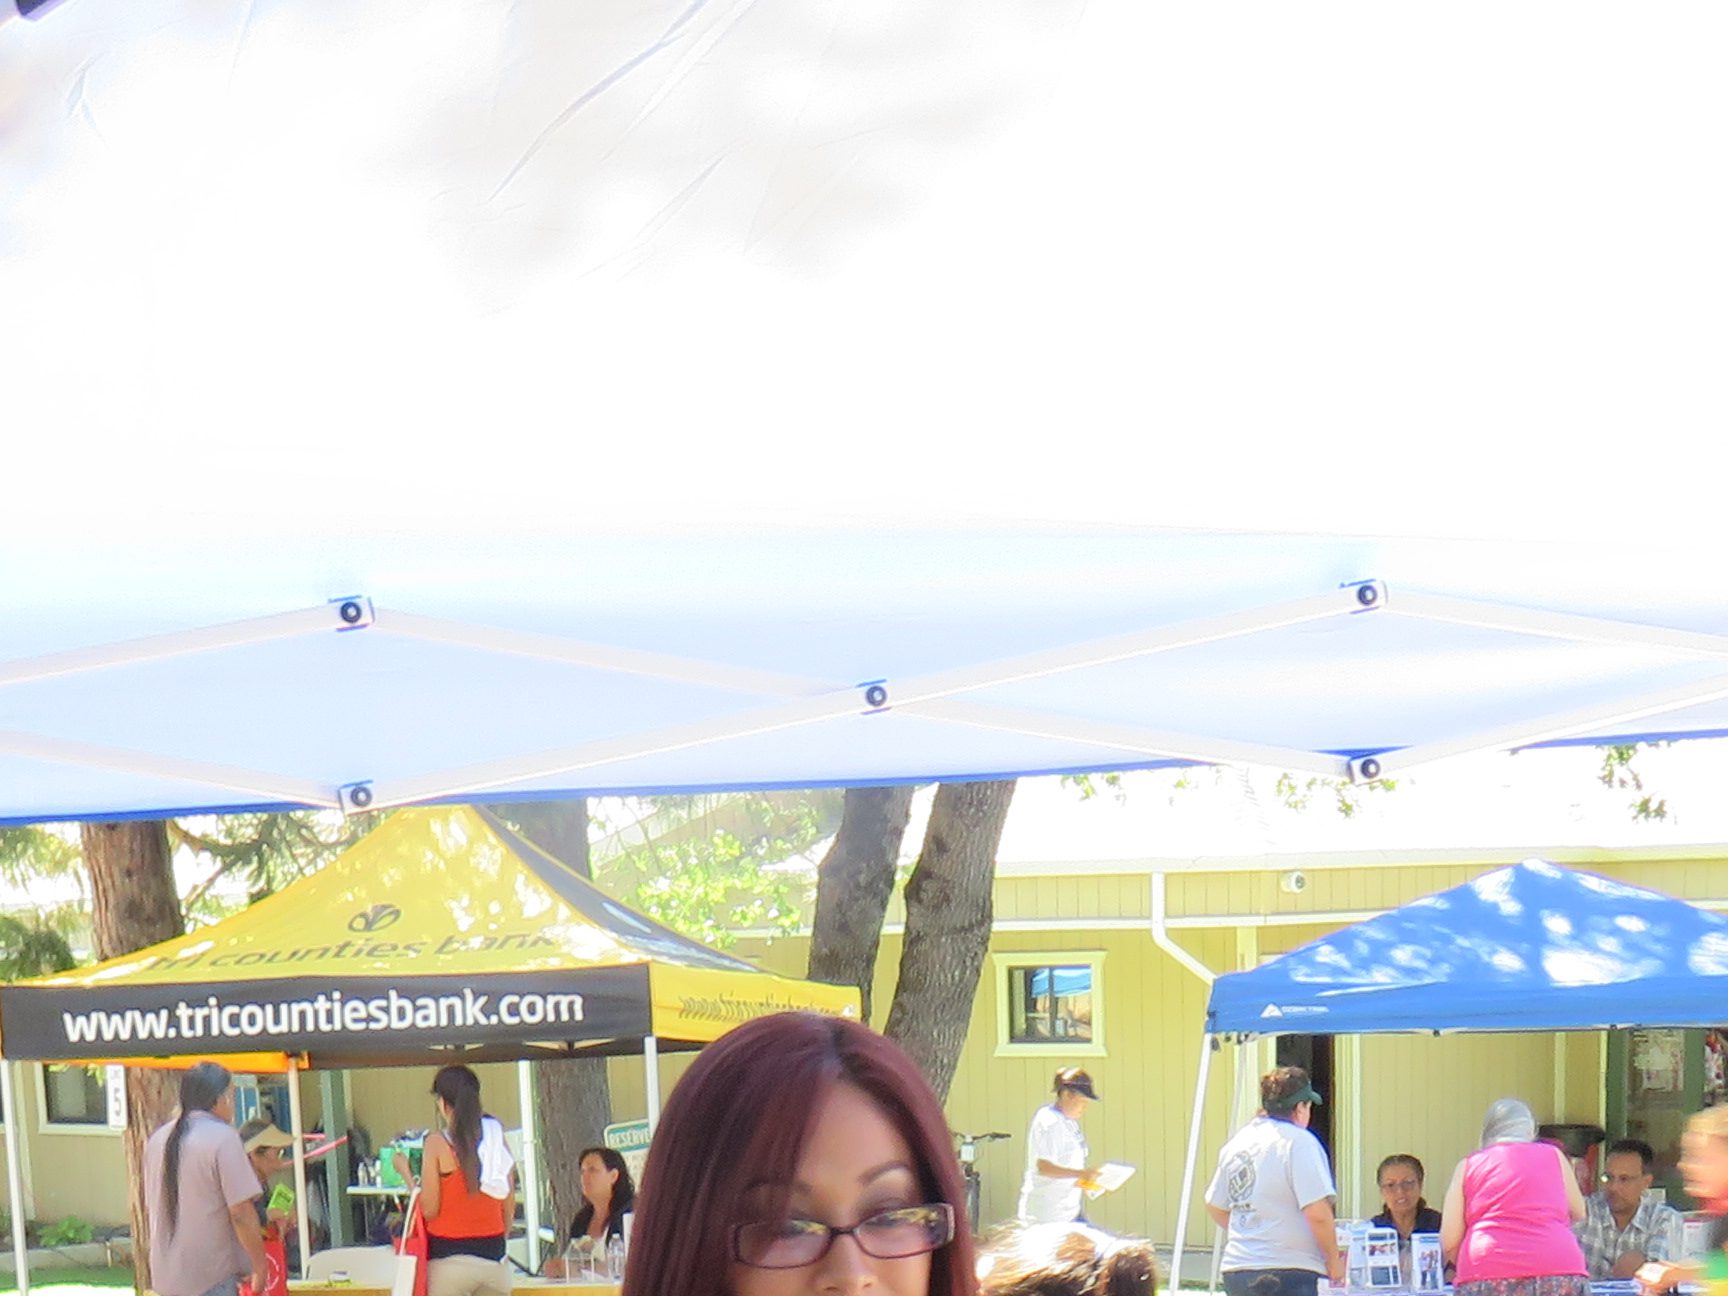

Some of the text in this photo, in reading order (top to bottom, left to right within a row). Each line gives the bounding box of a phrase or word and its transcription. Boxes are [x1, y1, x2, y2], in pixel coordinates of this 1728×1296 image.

[208, 938, 429, 968] counties
[432, 930, 558, 958] bank
[62, 987, 585, 1043] www.tricountiesbank.com
